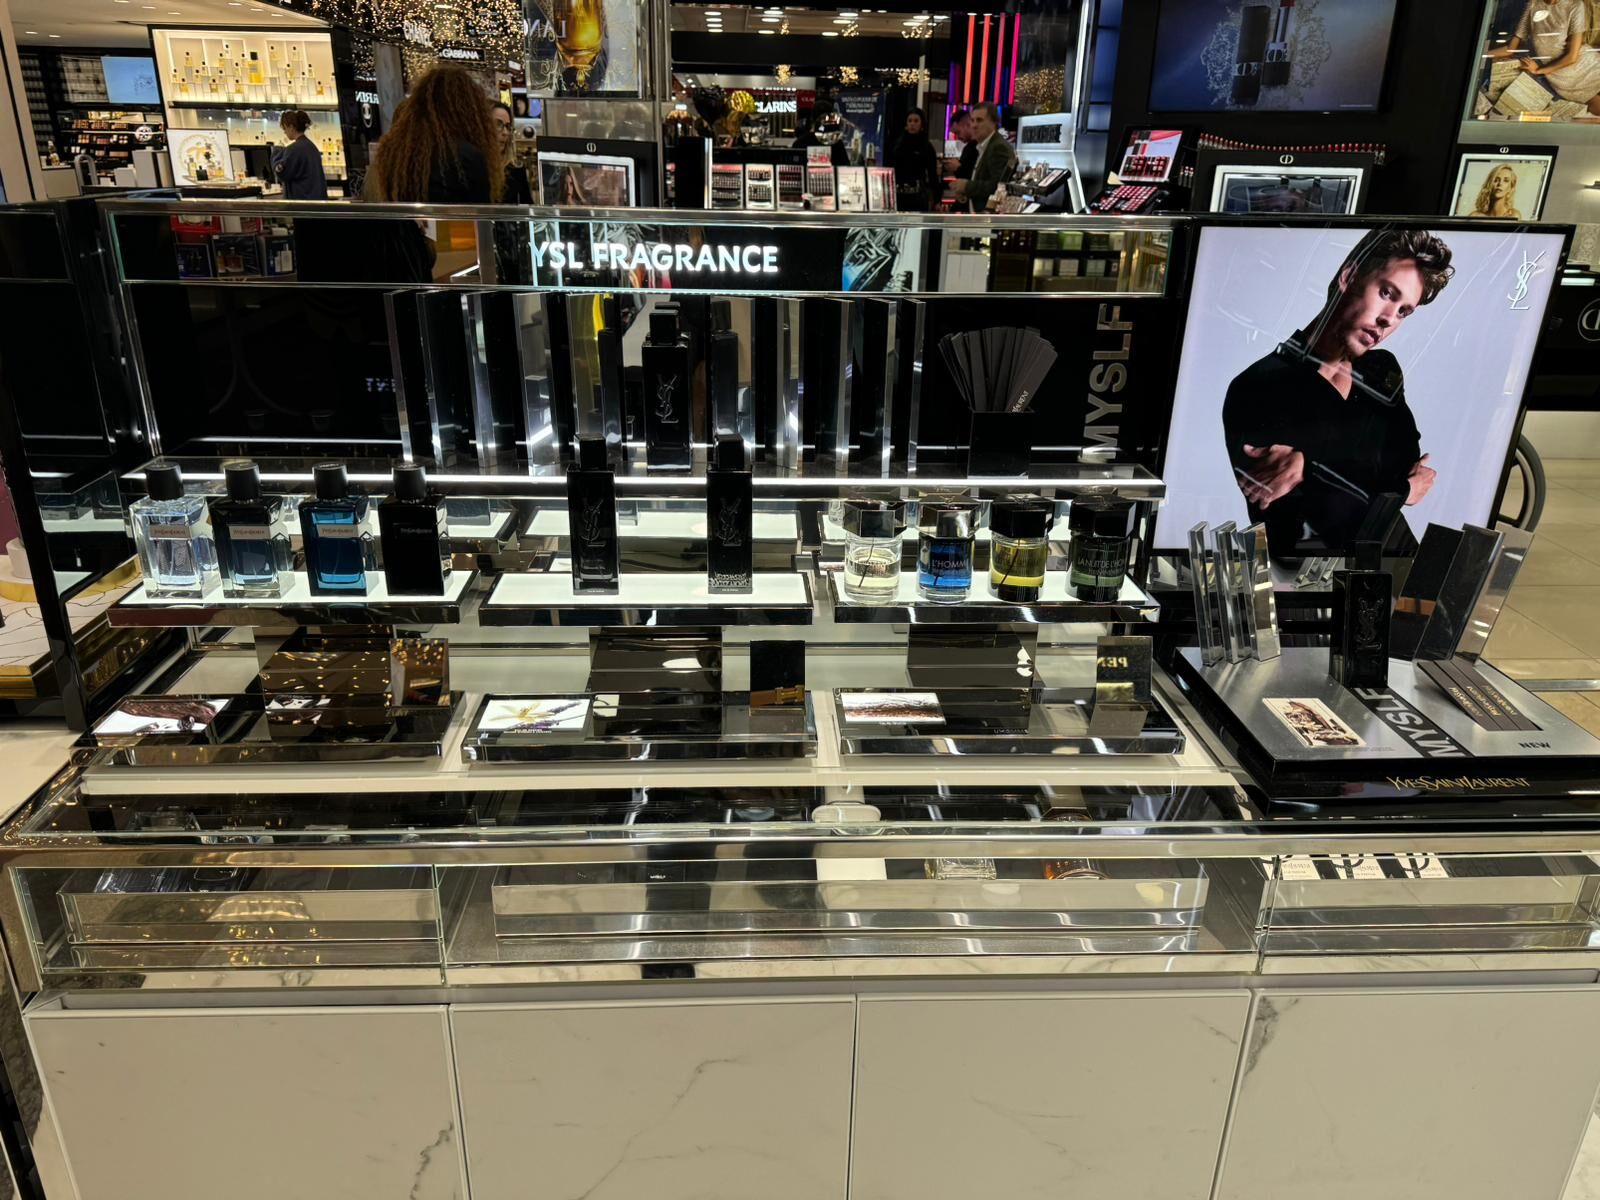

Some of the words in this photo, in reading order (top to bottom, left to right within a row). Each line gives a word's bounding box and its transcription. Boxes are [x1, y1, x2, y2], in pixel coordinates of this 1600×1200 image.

[529, 241, 584, 270] YSL
[593, 243, 779, 273] FRAGRANCE
[1081, 303, 1134, 460] MYSLF
[1354, 688, 1466, 758] MYSLF
